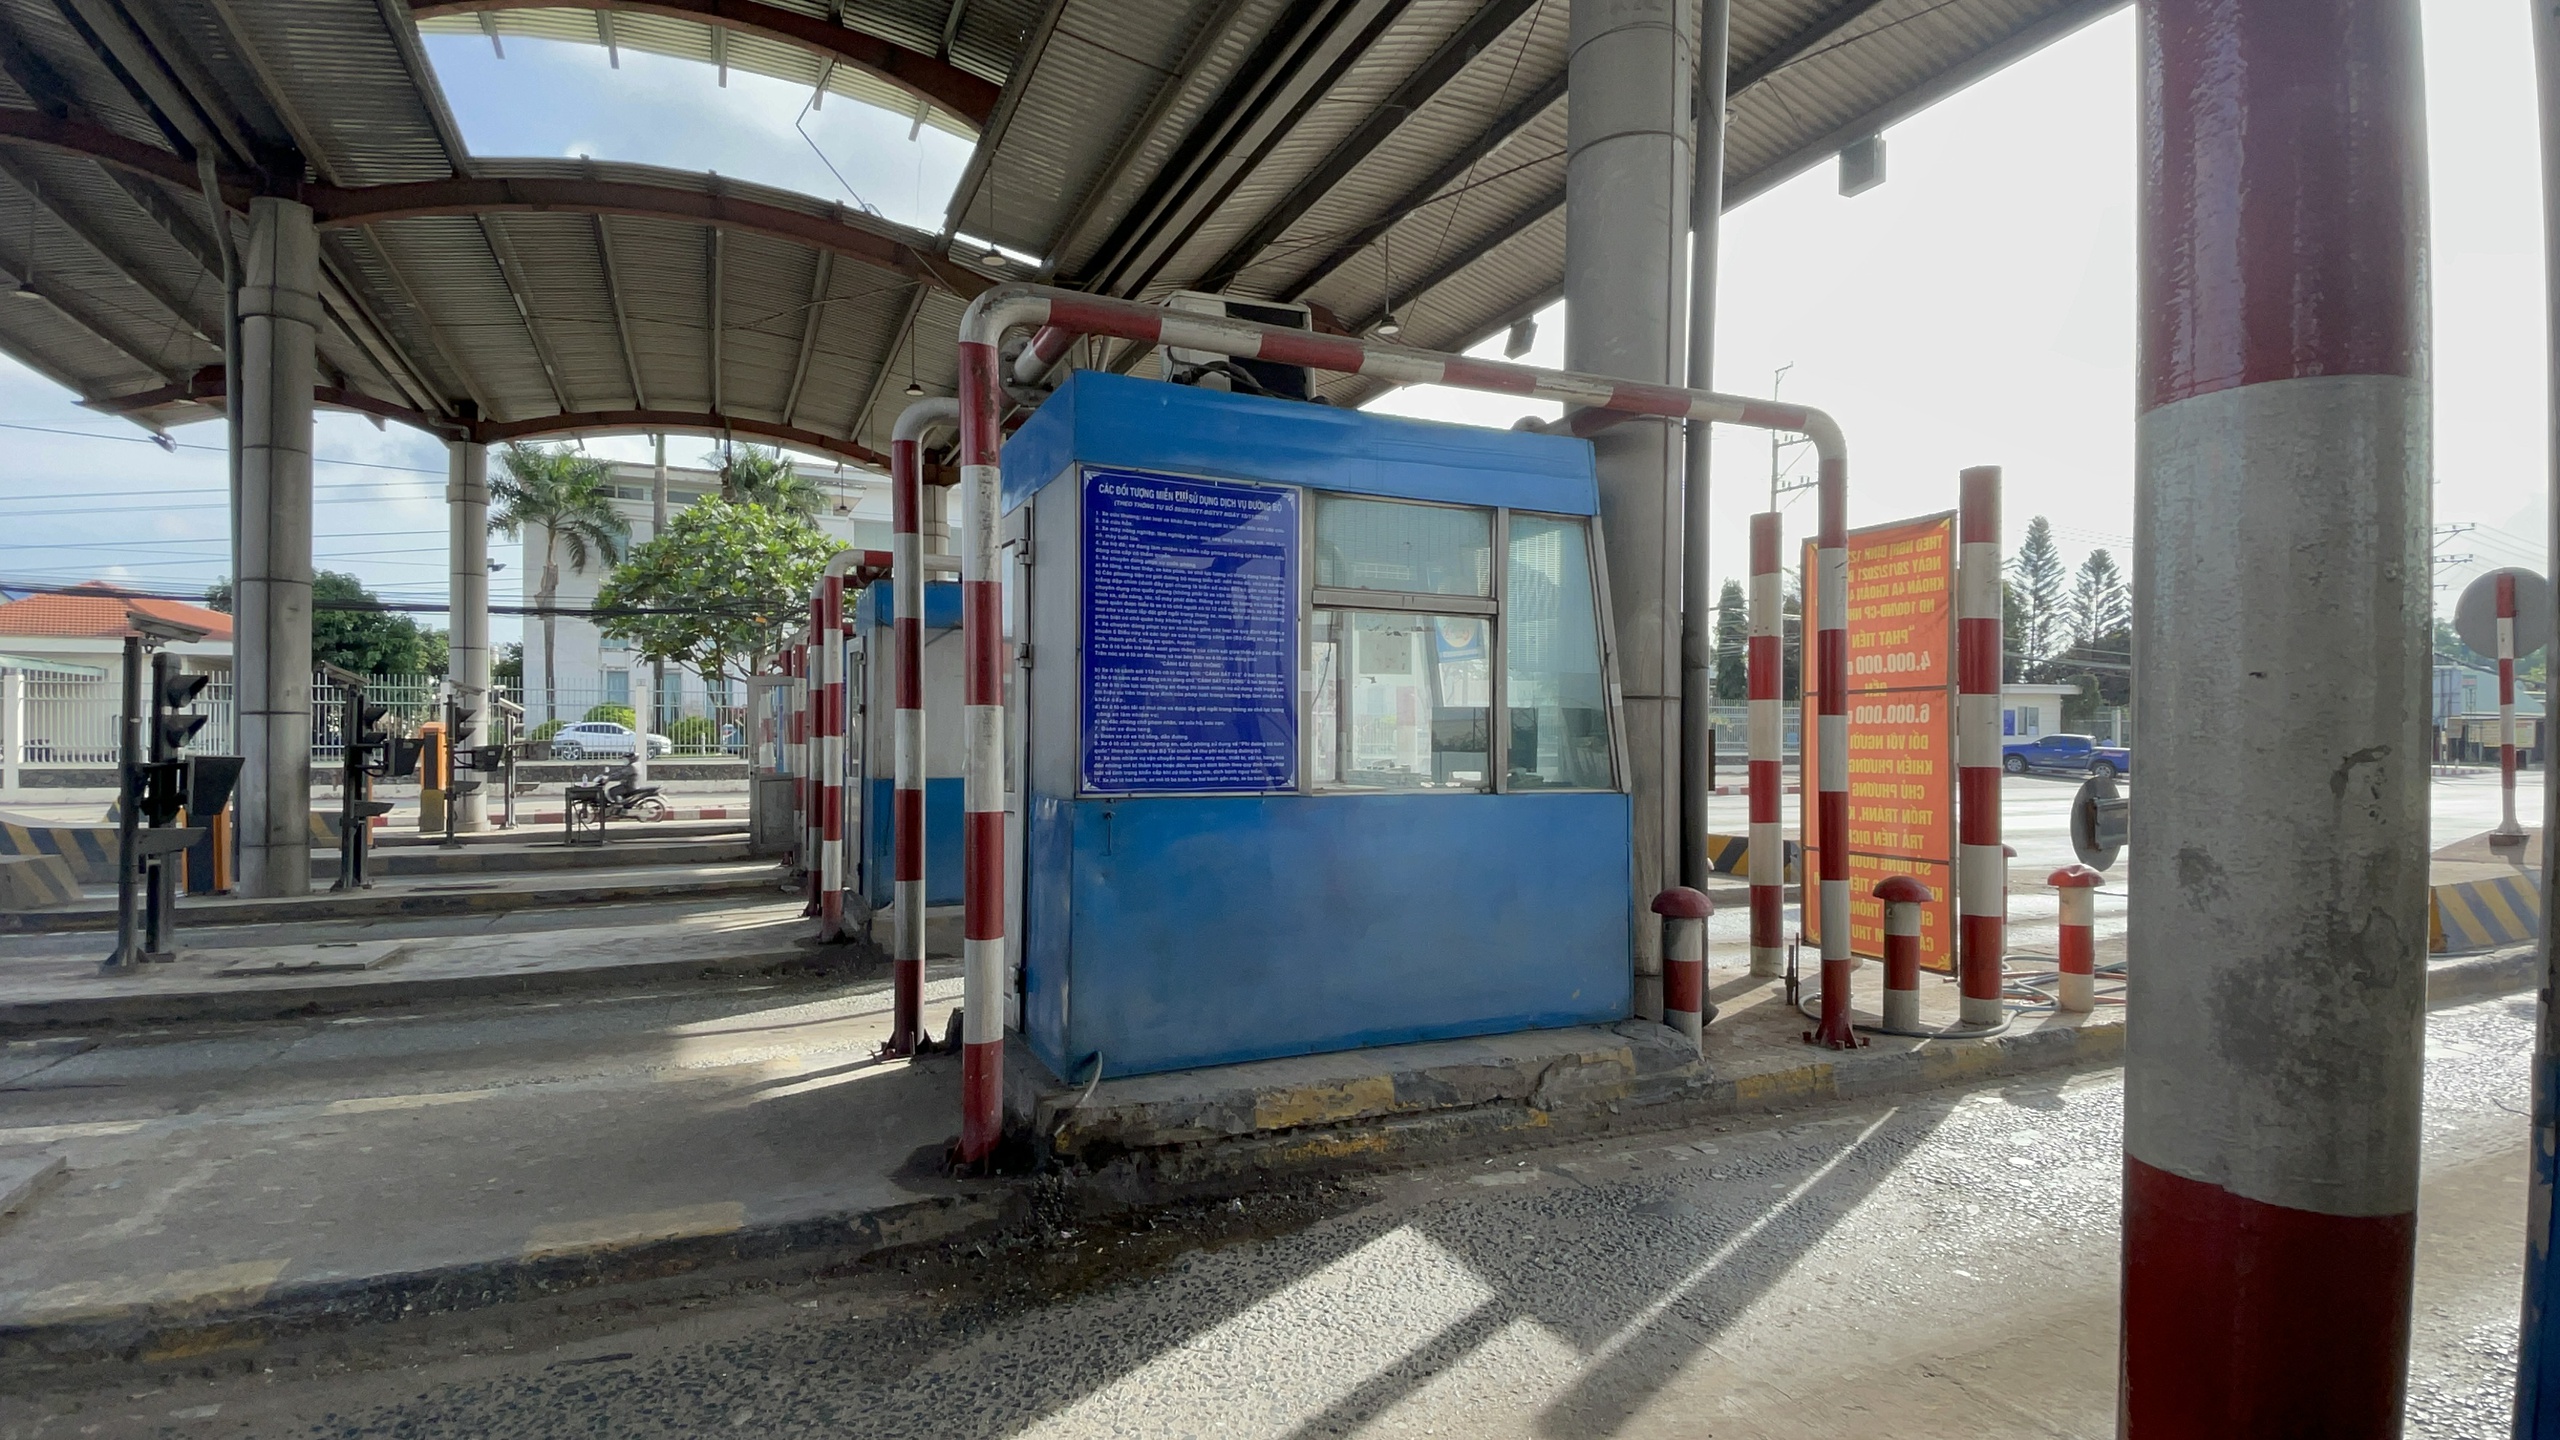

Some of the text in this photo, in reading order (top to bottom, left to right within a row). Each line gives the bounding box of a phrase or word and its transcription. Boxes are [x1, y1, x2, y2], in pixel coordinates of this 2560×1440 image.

[1099, 482, 1114, 494] CÁC
[1199, 495, 1218, 508] DỤNG
[1220, 497, 1236, 509] DỊCH
